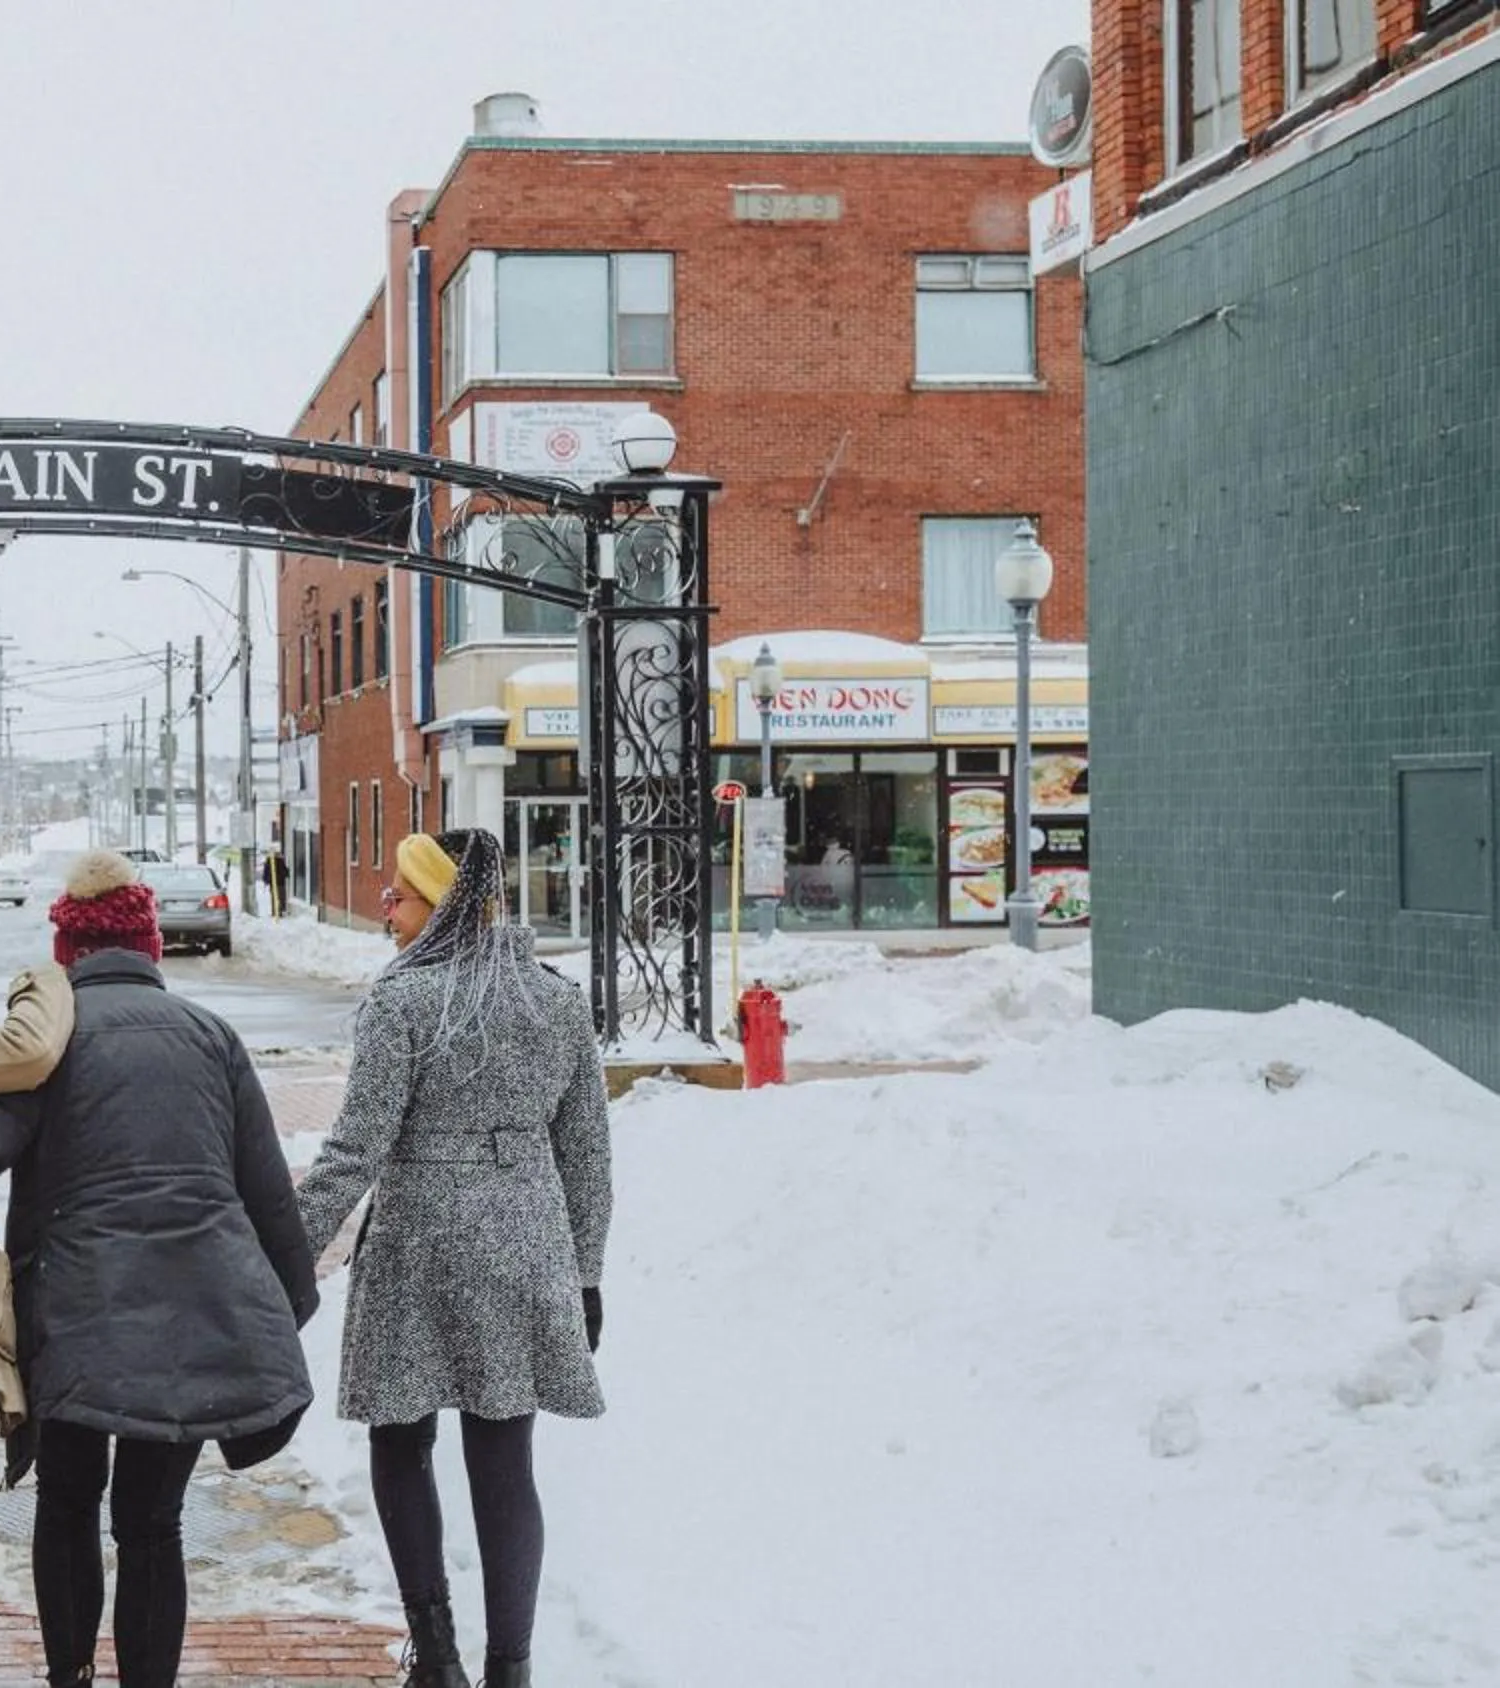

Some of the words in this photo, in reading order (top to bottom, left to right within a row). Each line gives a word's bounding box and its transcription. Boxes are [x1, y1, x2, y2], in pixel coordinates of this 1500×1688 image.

[132, 455, 220, 513] ST.
[827, 686, 914, 711] DONG
[770, 714, 897, 728] RESTAURANT
